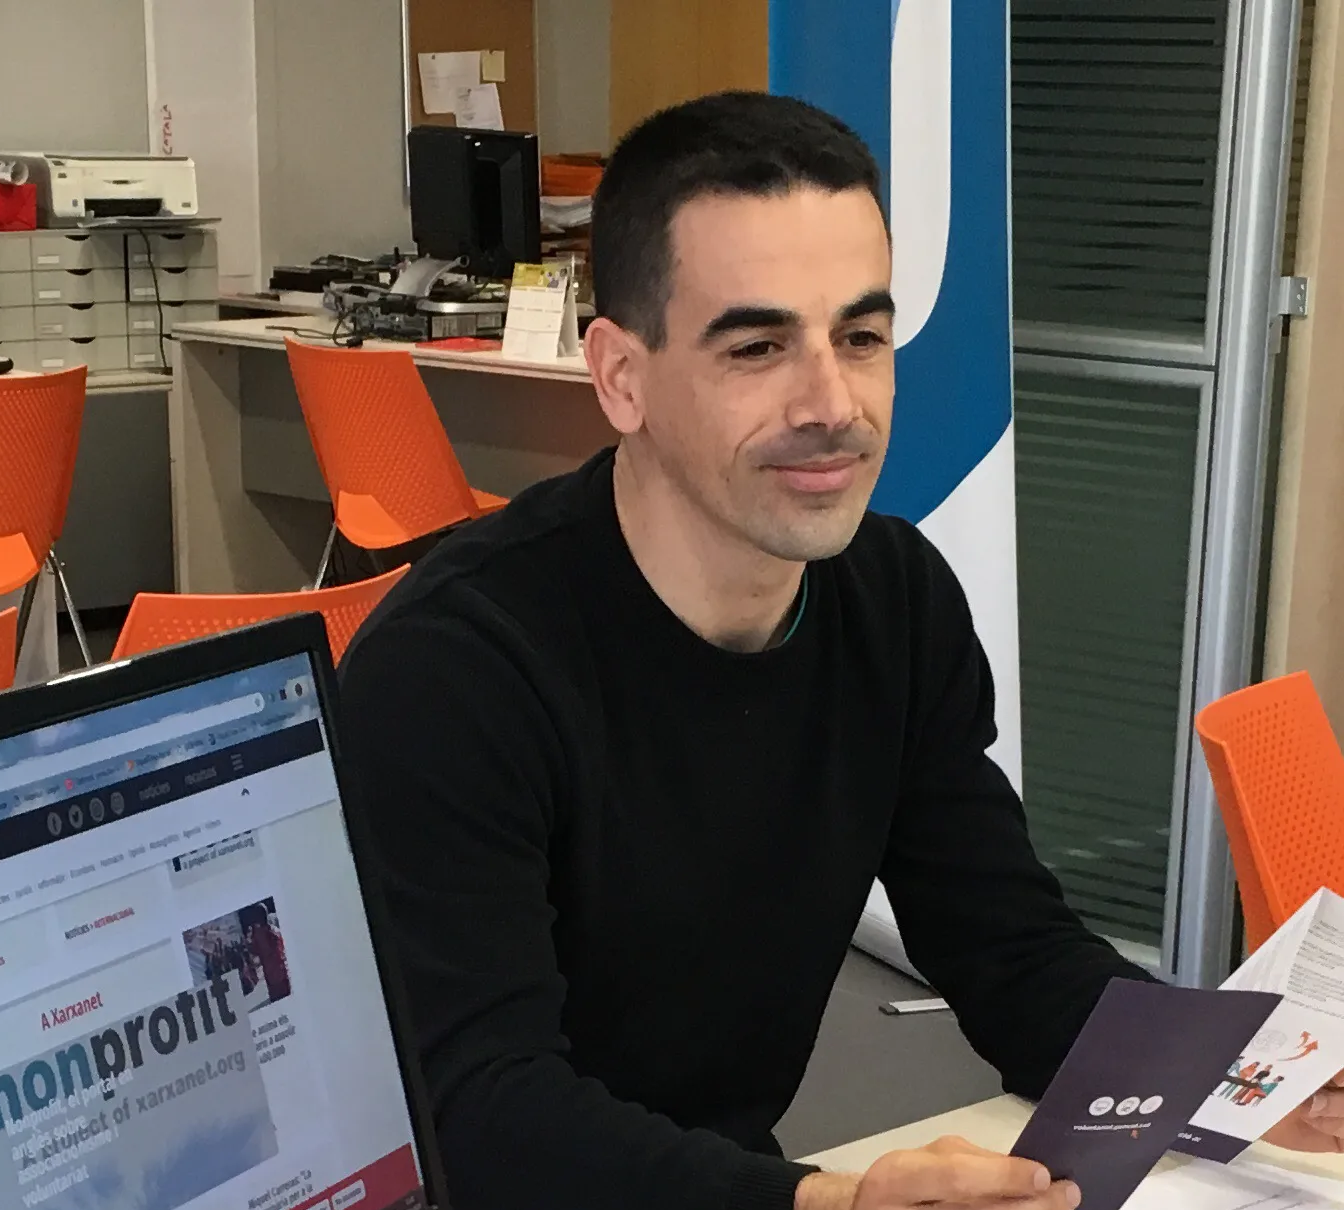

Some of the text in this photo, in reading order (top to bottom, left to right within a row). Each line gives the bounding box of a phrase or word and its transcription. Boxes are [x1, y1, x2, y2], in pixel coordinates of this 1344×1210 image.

[39, 989, 103, 1032] A Xarxanet
[109, 1049, 246, 1126] of xarxanet.org
